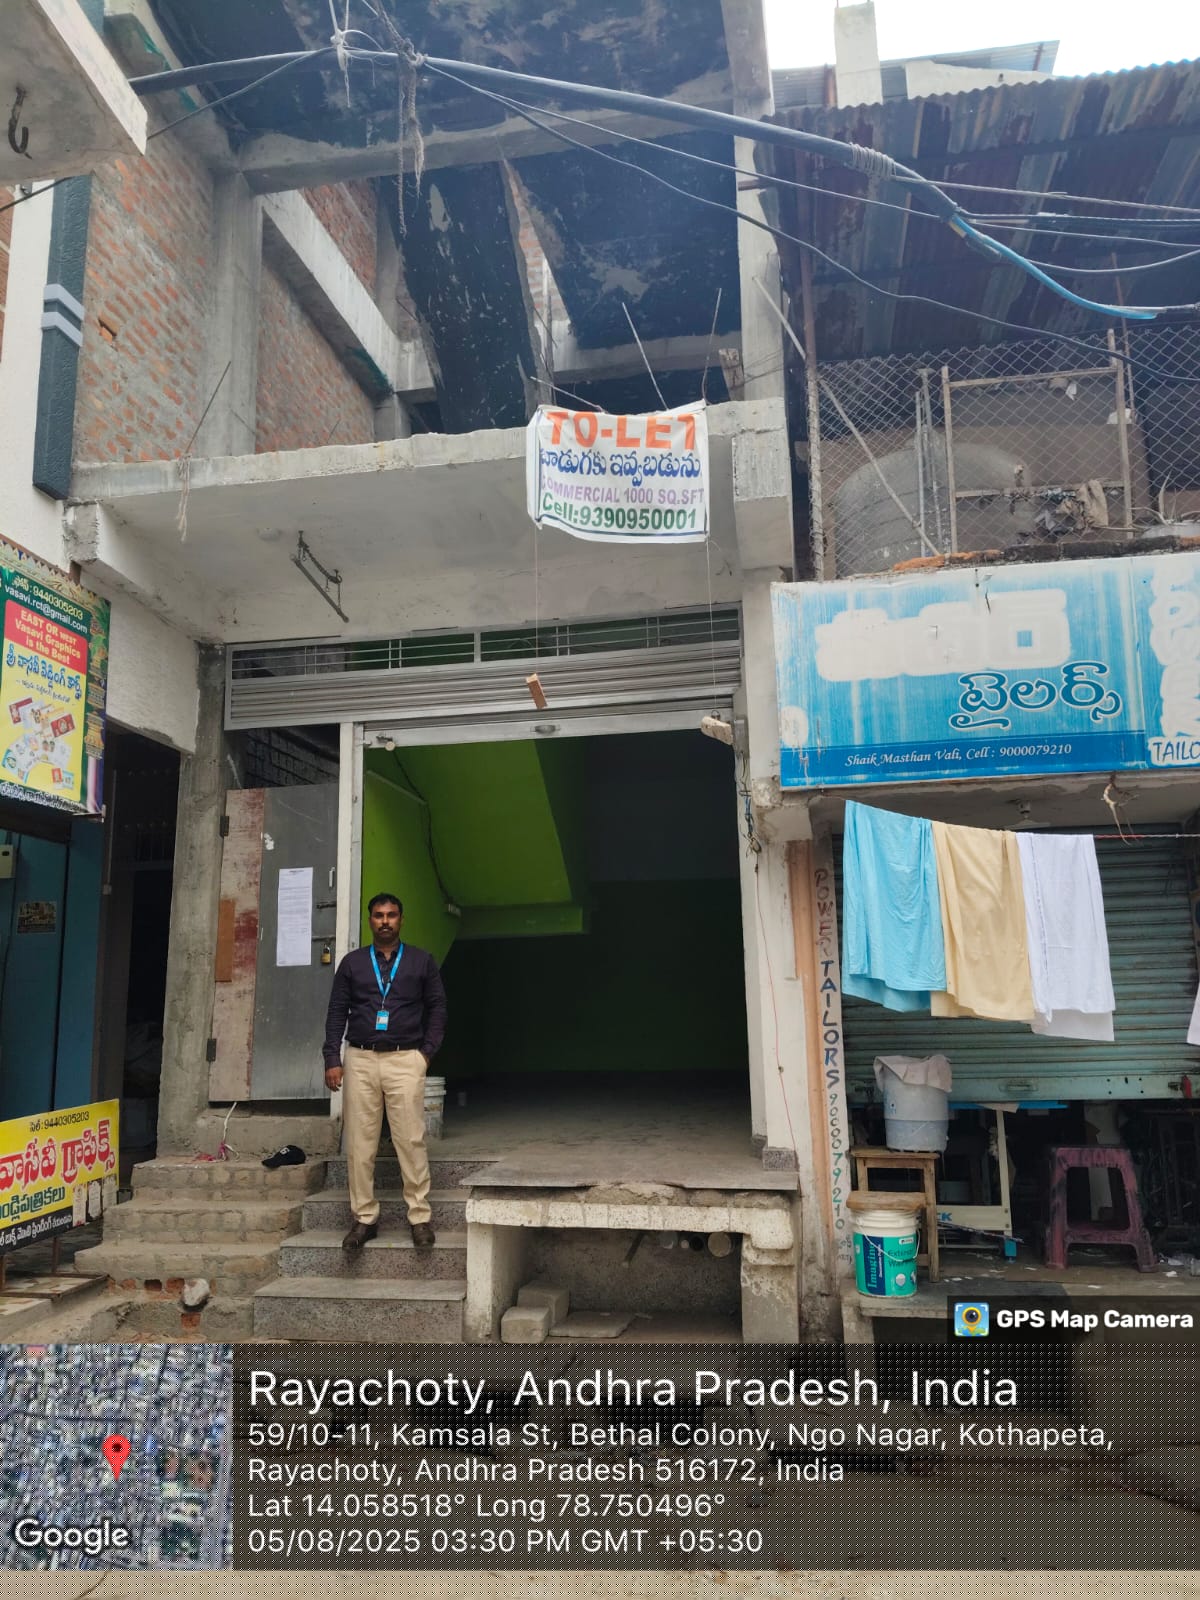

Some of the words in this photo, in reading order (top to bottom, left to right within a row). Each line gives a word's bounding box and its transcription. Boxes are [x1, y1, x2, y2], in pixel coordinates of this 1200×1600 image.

[546, 411, 696, 450] TO-LET
[623, 487, 653, 504] 1000
[658, 488, 705, 505] SQ.SFT
[15, 619, 44, 640] Vasavi
[45, 634, 81, 659] Graphics
[21, 610, 45, 628] EAST
[46, 620, 59, 636] OR
[60, 631, 77, 645] WEST
[26, 636, 34, 647] is
[36, 640, 50, 655] the
[51, 648, 71, 665] Best
[949, 660, 1123, 730] టైలర్స్
[845, 755, 880, 767] Shaik
[880, 751, 931, 764] Masthan
[999, 744, 1072, 757] 9000079210
[820, 960, 840, 1090] TAILORS
